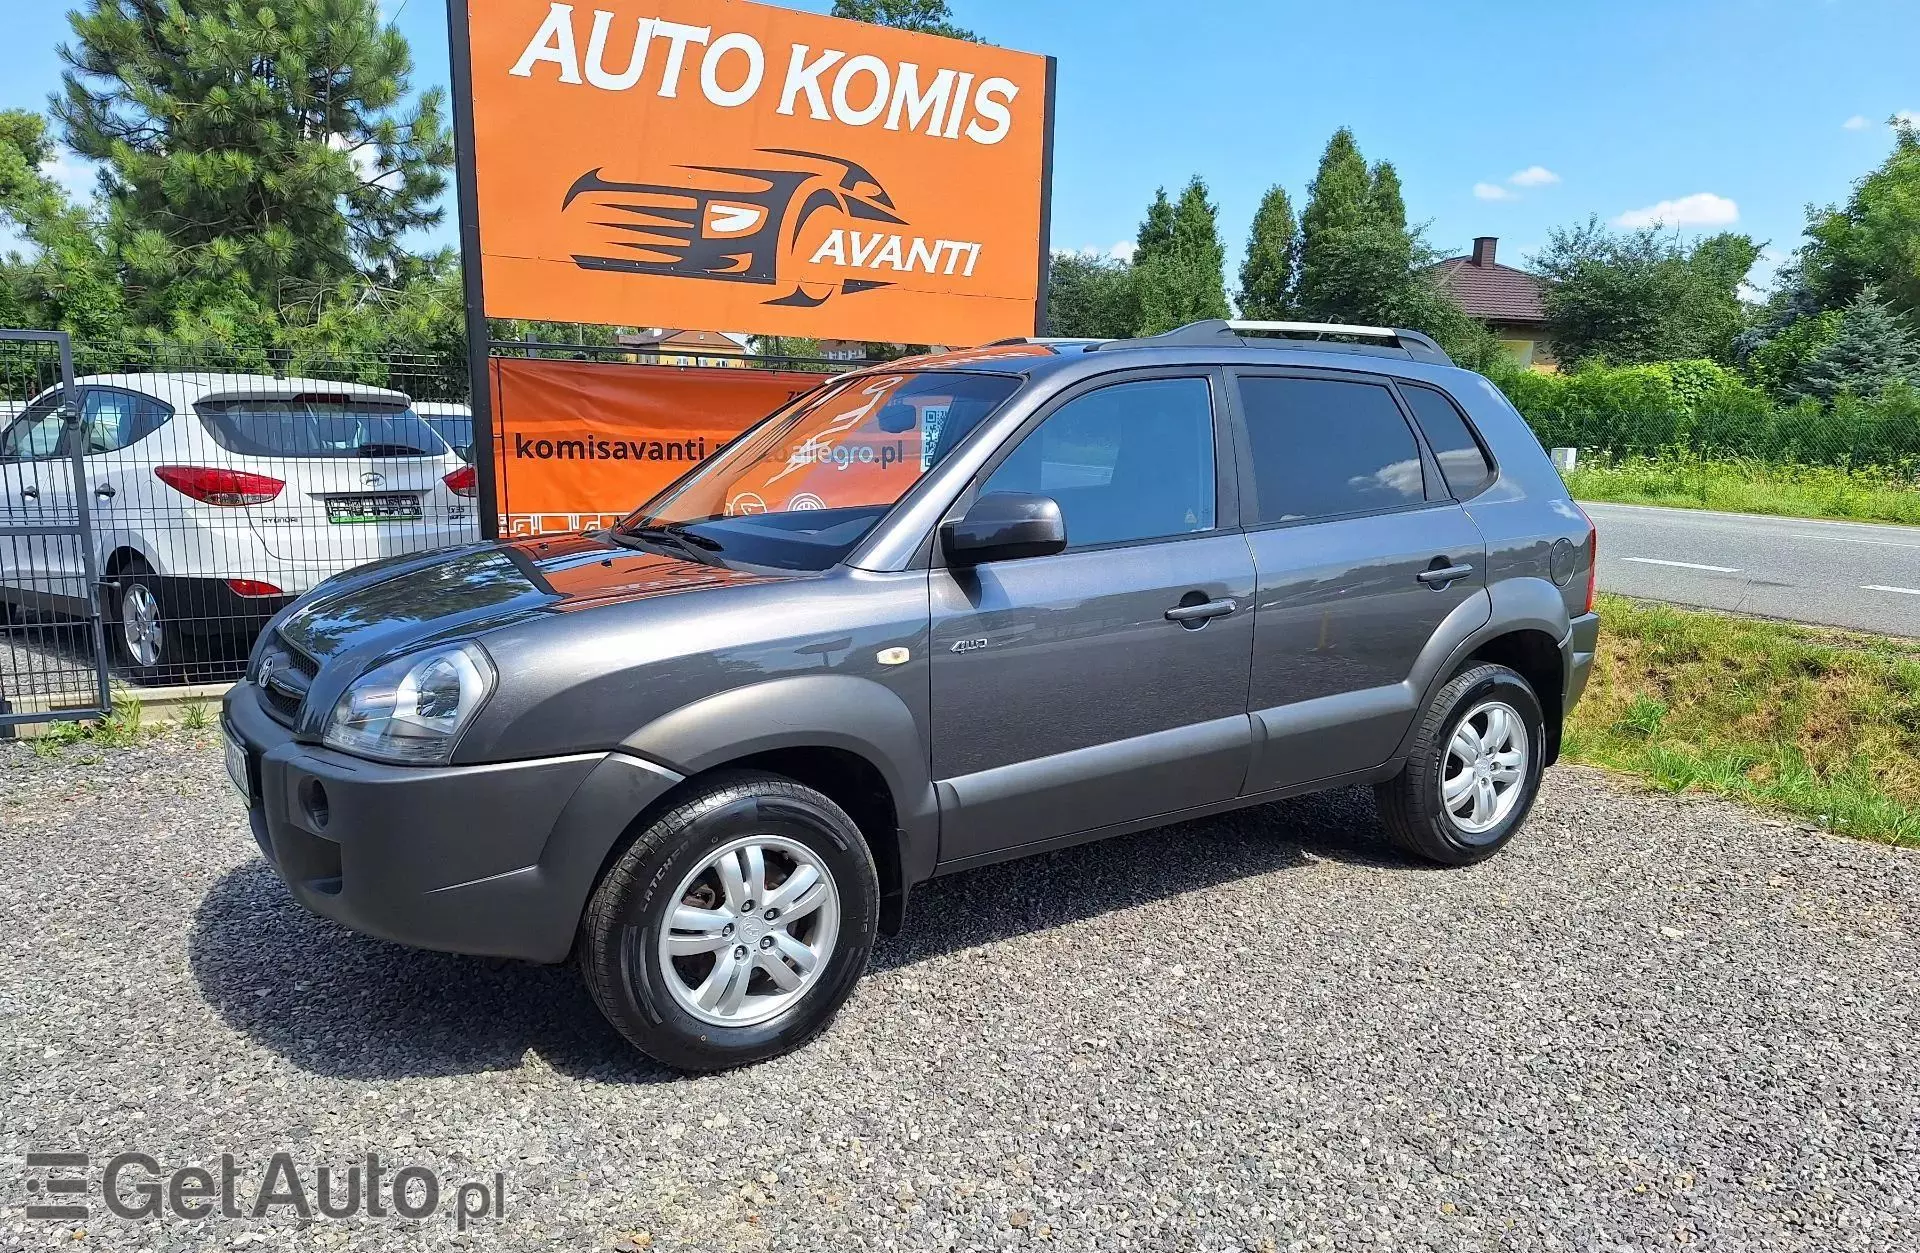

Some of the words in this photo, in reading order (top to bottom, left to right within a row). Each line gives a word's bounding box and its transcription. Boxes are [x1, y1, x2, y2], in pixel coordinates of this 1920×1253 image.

[508, 2, 765, 107] AUTO
[776, 43, 1019, 145] KOMIS
[809, 229, 982, 277] AVANTI
